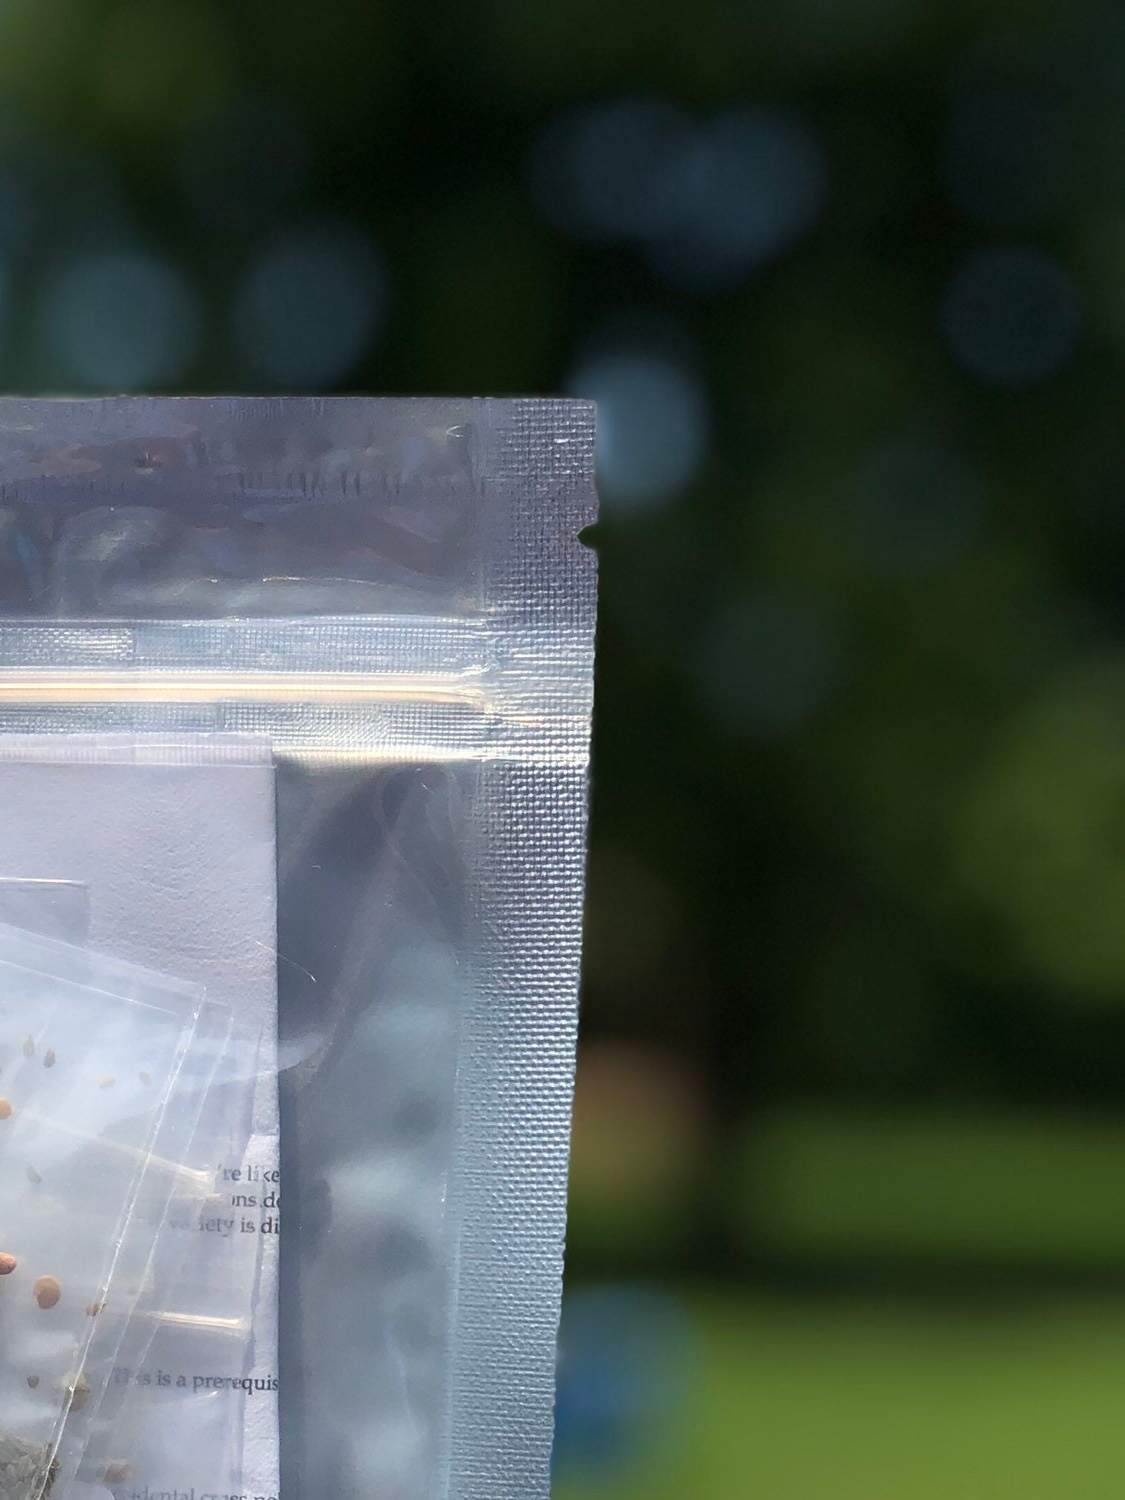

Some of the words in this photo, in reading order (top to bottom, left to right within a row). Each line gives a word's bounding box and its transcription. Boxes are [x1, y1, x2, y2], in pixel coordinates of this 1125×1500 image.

[240, 1217, 256, 1234] is
[156, 1370, 172, 1386] is
[177, 1375, 187, 1388] a
